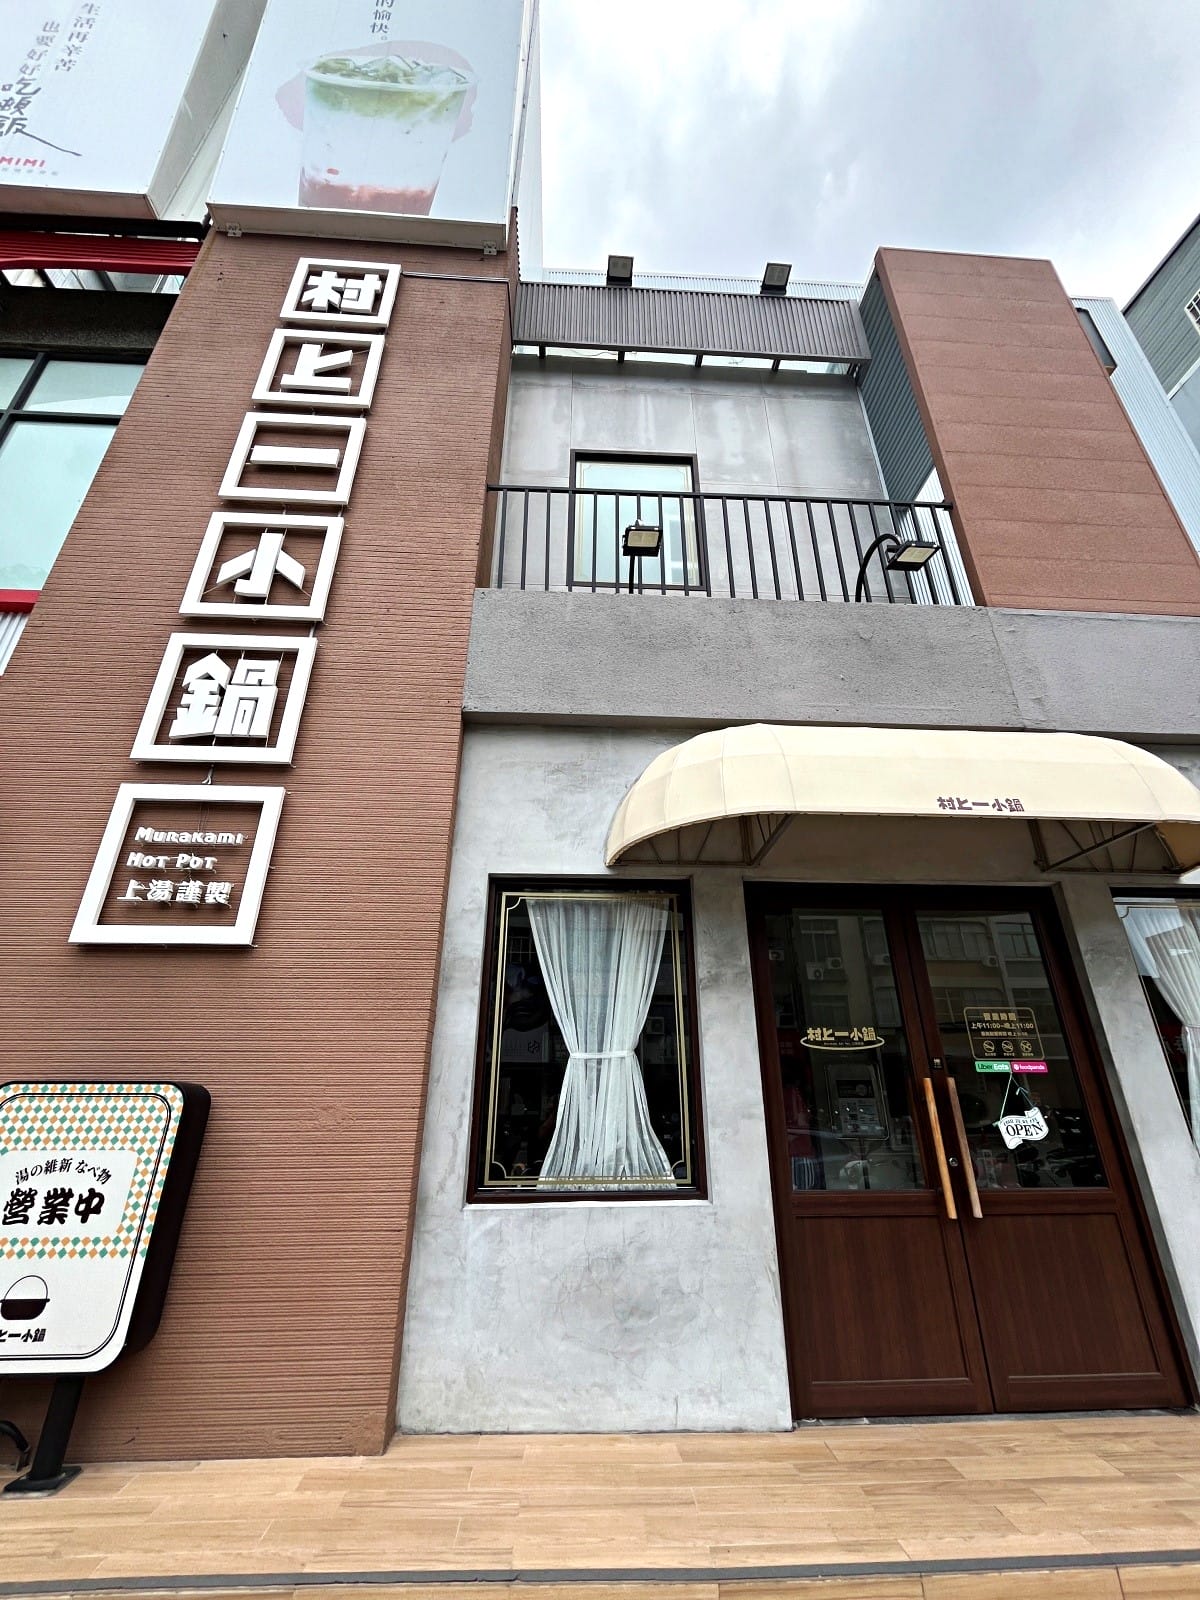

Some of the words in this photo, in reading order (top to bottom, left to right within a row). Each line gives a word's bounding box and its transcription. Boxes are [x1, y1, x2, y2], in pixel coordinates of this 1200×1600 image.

[1005, 1121, 1043, 1137] OPEN
[2, 1187, 105, 1225] 營業中
